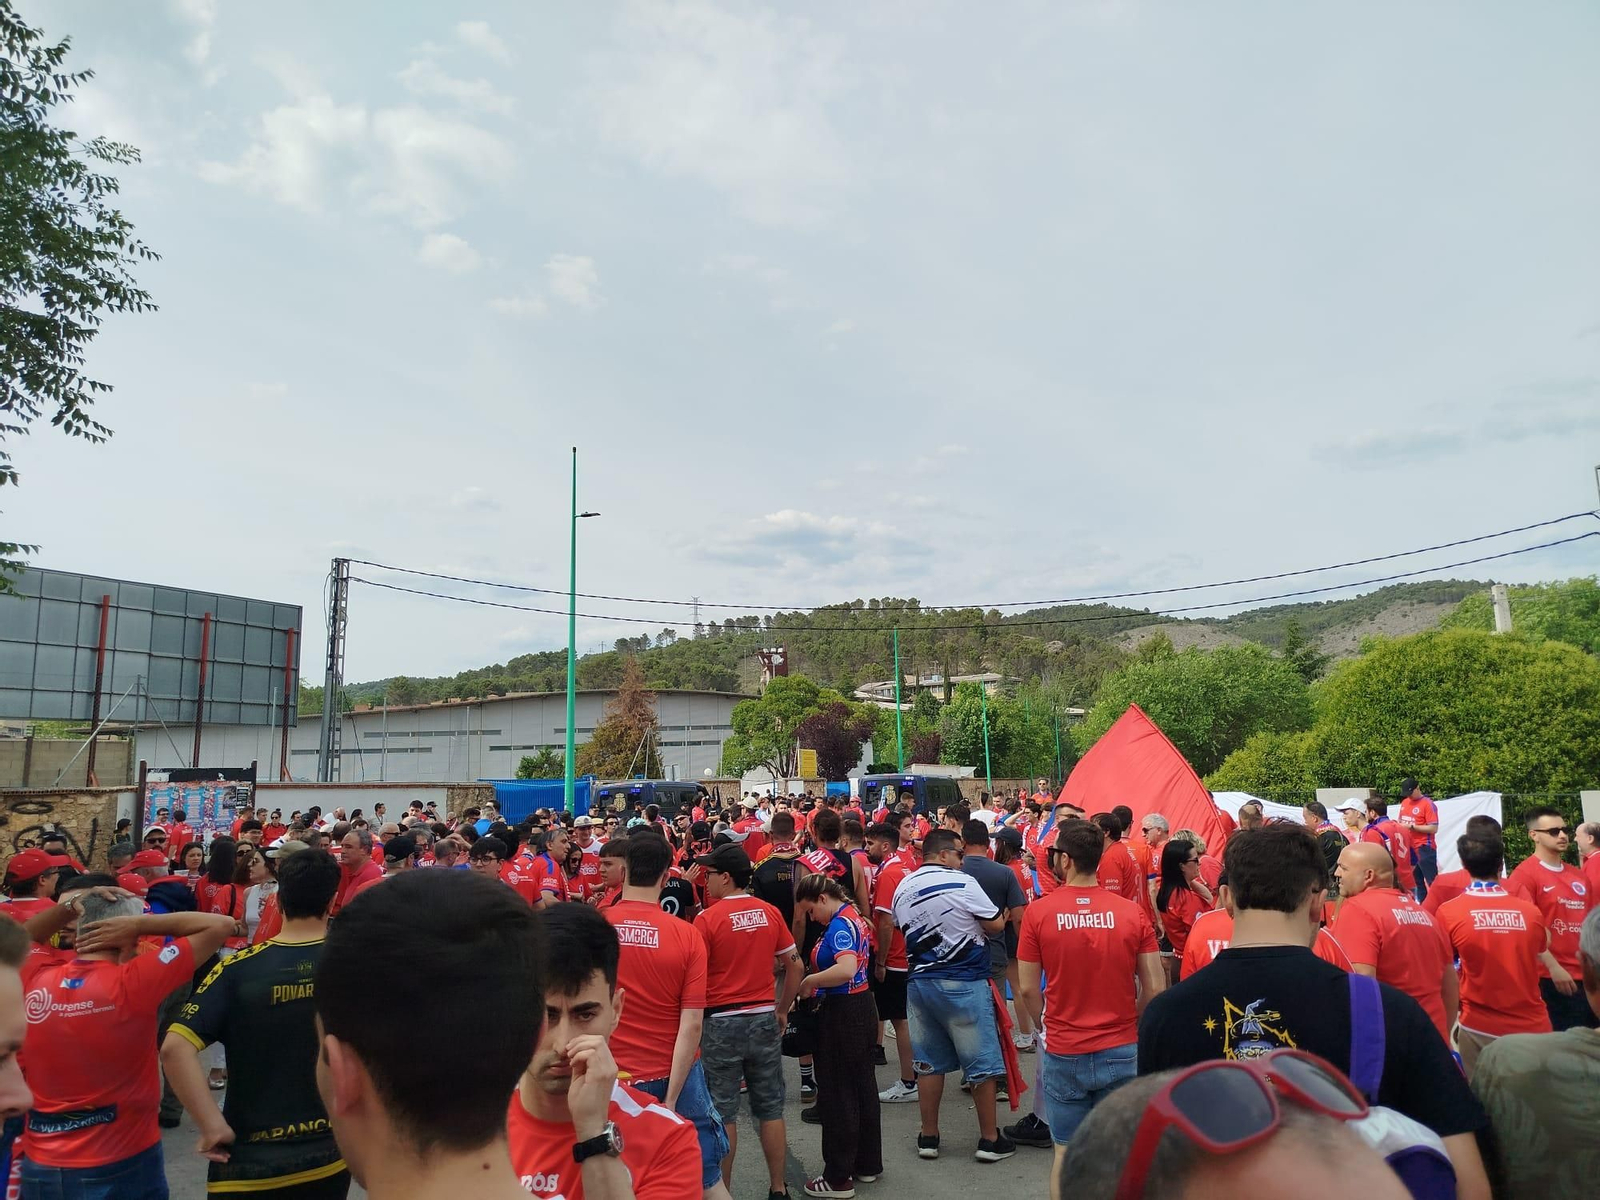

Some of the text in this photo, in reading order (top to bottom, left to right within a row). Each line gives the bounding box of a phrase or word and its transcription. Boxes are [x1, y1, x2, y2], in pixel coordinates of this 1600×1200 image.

[1056, 911, 1115, 931] POVARELO
[1470, 911, 1526, 930] ESMORGA
[51, 1000, 94, 1012] ourense
